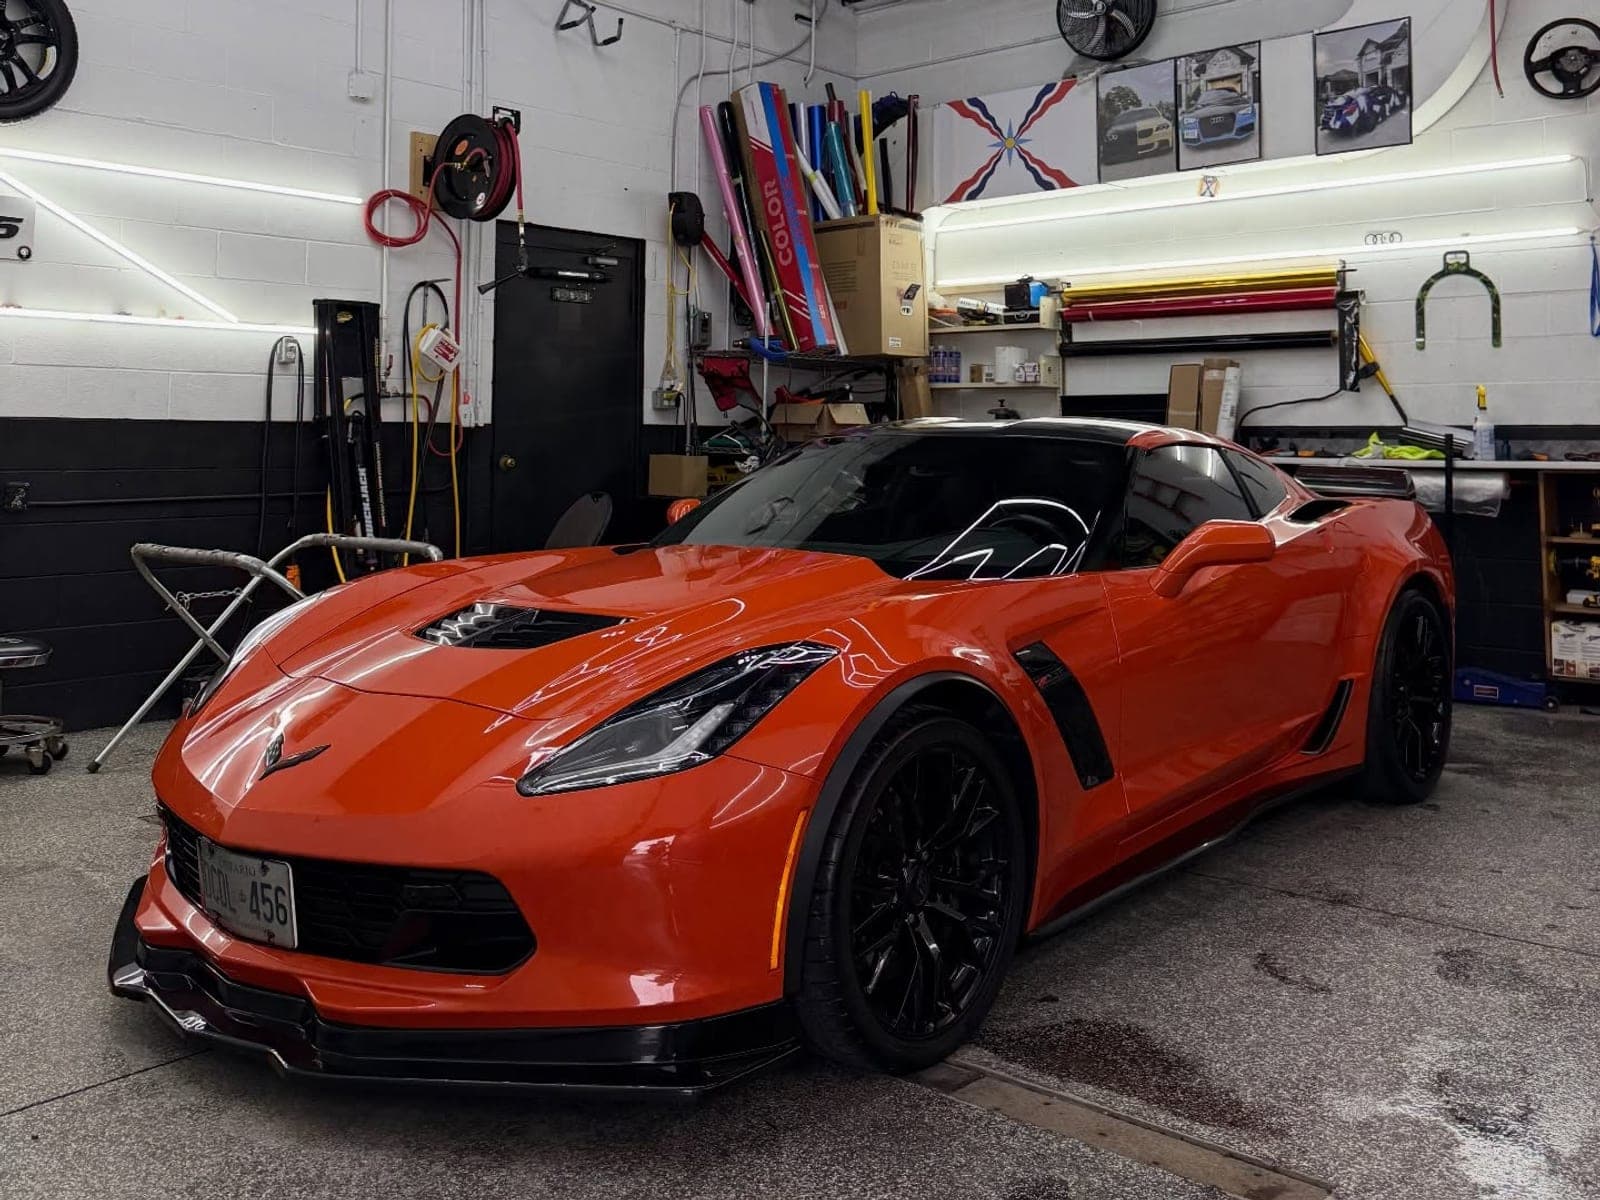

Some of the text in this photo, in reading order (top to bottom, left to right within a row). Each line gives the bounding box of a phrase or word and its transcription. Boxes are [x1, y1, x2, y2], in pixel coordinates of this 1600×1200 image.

[763, 179, 793, 267] COLOR
[358, 466, 375, 538] UICKJACK
[249, 881, 288, 926] 456
